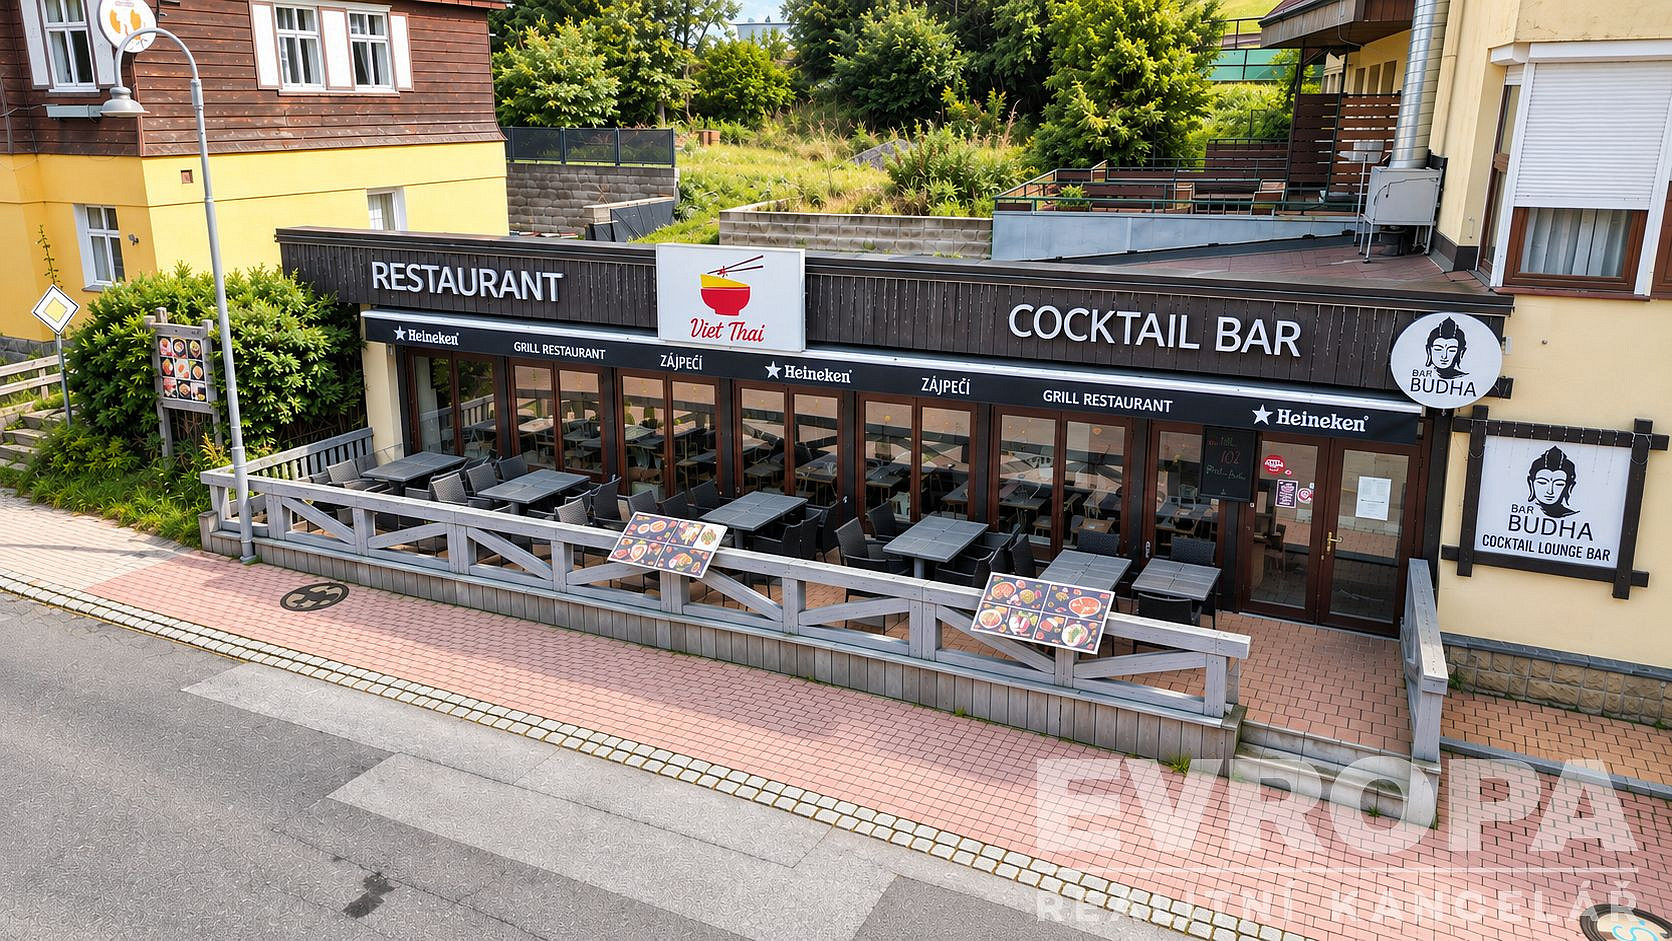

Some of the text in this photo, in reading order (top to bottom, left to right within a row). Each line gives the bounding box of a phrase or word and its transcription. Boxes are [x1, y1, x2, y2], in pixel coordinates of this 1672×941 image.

[371, 261, 564, 302] RESTAURANT
[690, 318, 766, 342] Viet Thai
[1008, 303, 1302, 358] COCKTAIL BAR
[513, 341, 606, 360] GRILL RESTAURANT
[784, 364, 852, 384] Heineken
[1412, 369, 1433, 377] BAR
[921, 375, 971, 396] ZÁJPEČÍ
[1410, 378, 1477, 397] BUDHA
[1042, 390, 1173, 413] GRILL RESTAURANT
[1276, 408, 1369, 432] Heineken
[1511, 504, 1534, 515] BAR
[1508, 515, 1593, 541] BUDHA
[1482, 534, 1611, 562] COCKTAIL LOUNGE BAR
